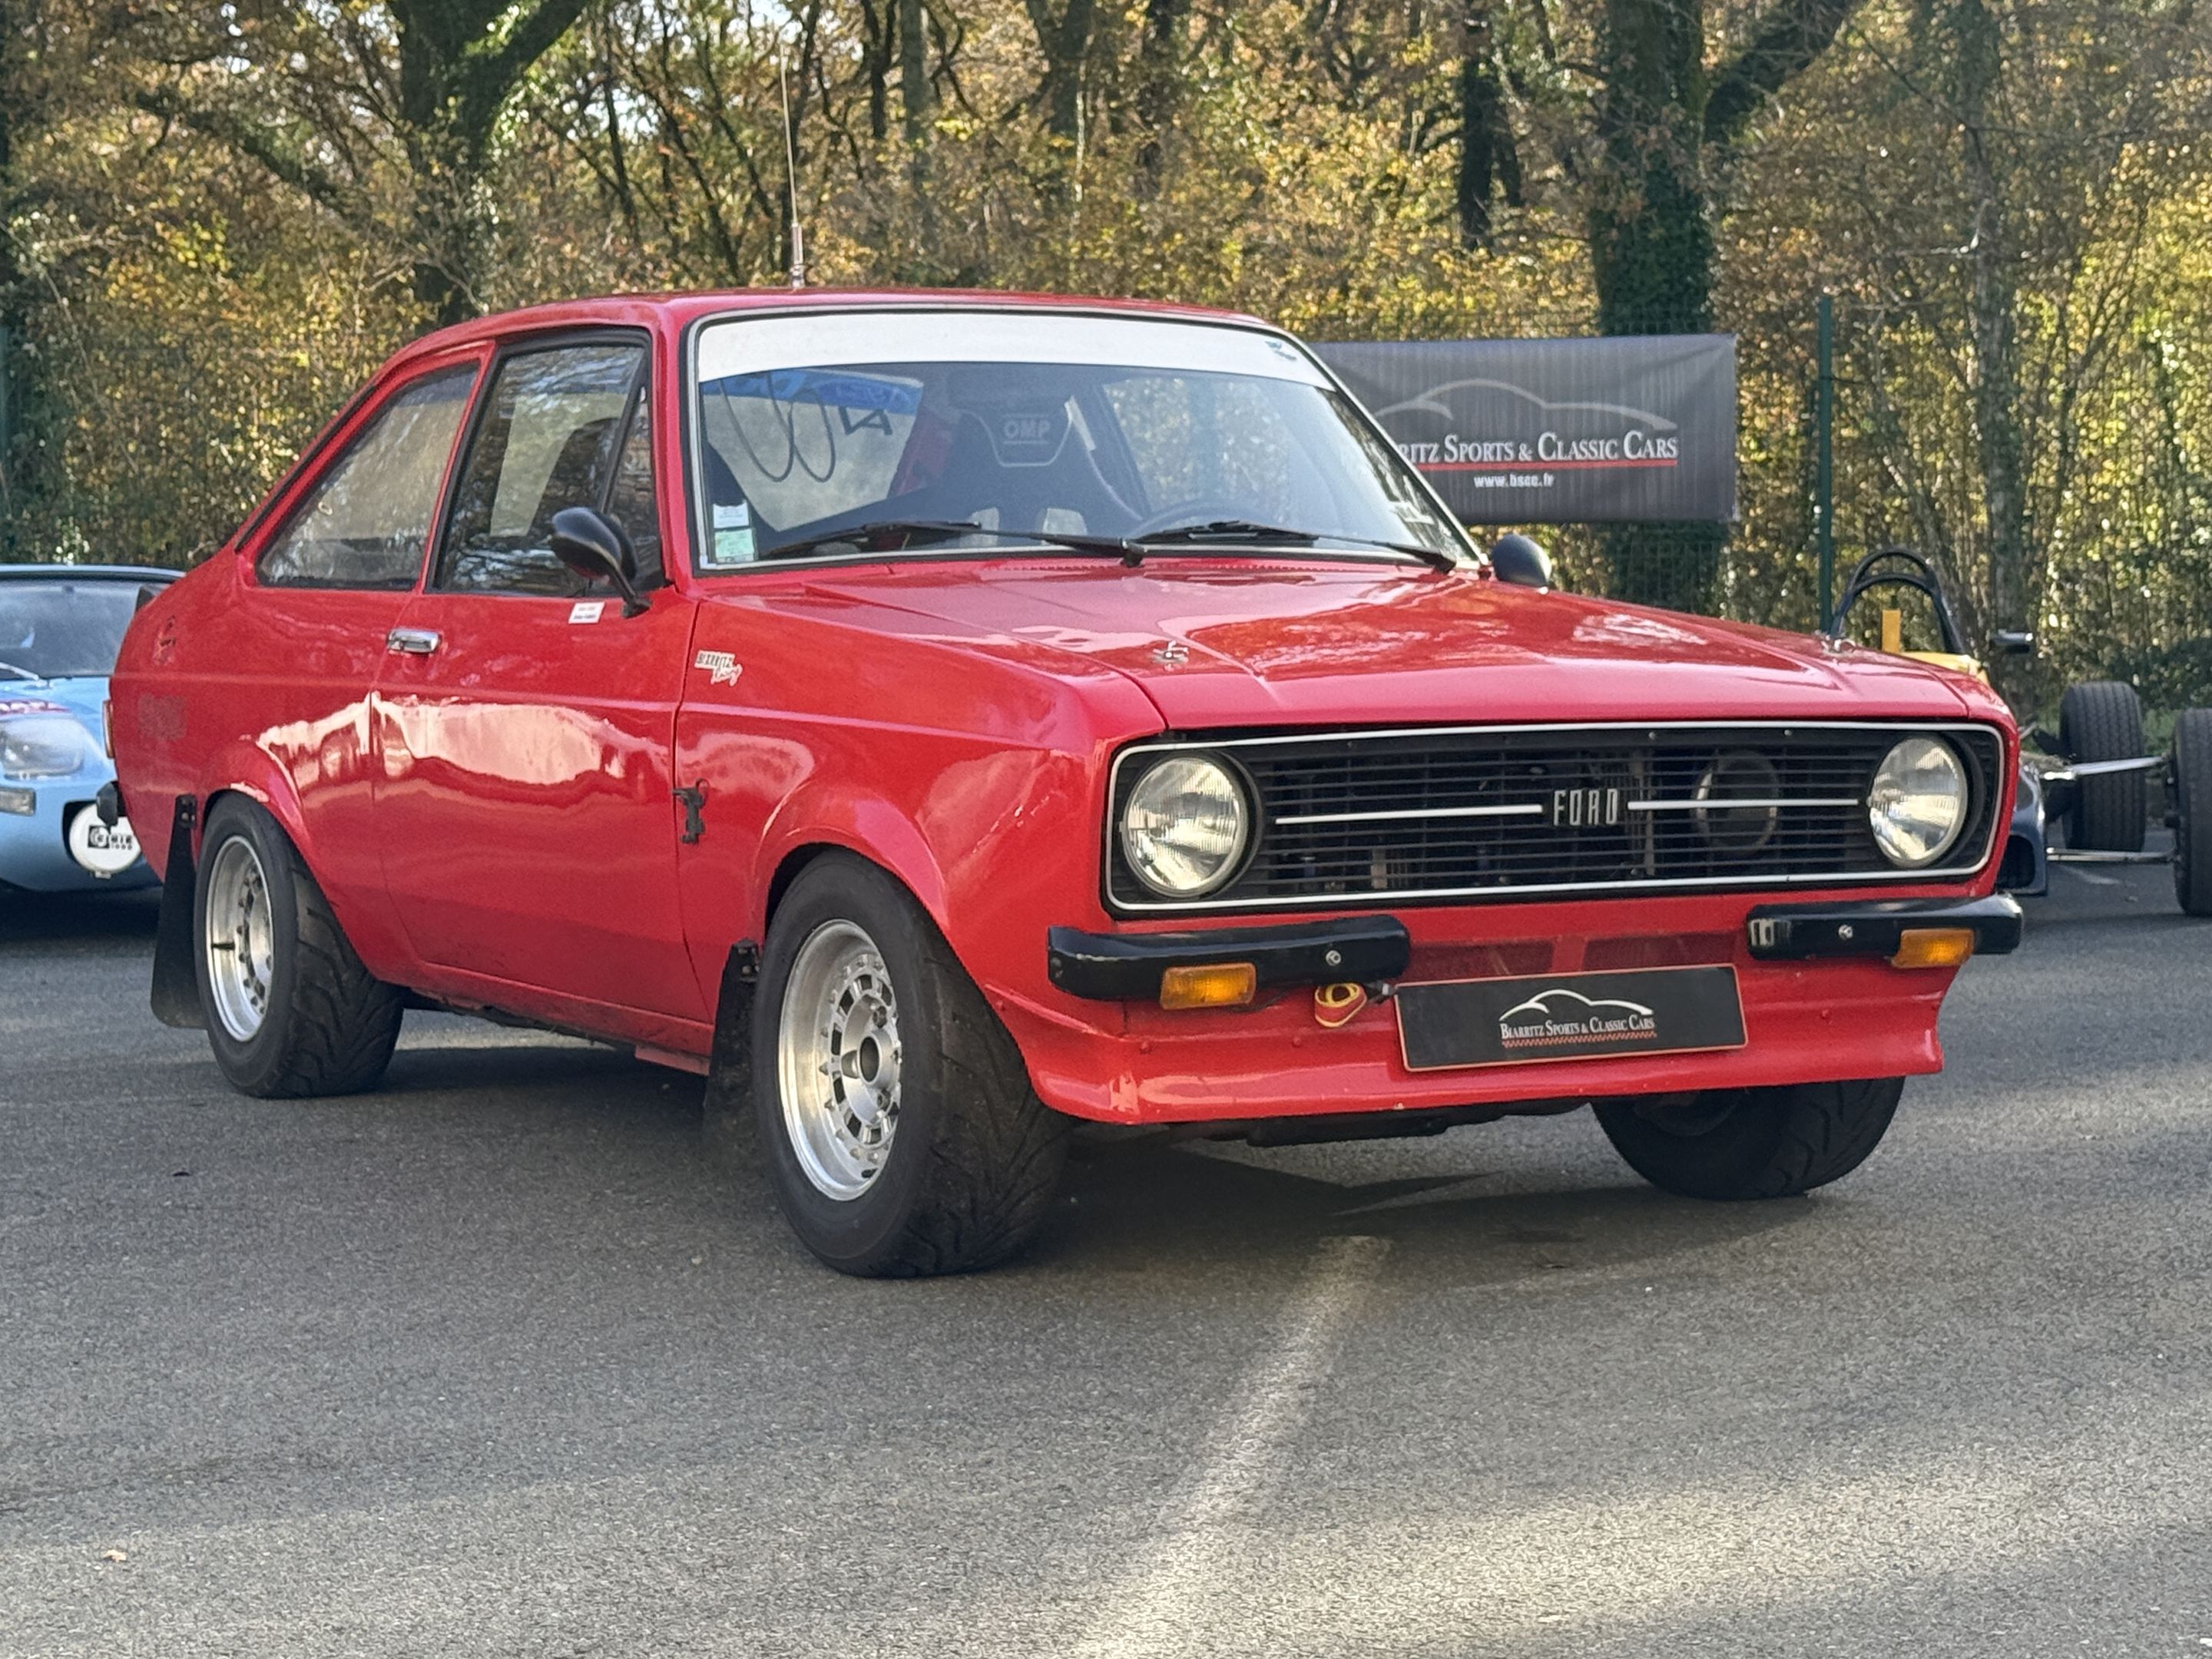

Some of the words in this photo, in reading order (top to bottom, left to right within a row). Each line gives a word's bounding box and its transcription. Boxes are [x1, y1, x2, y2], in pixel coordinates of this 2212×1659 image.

[1004, 419, 1051, 439] OMP
[1397, 442, 1439, 463] RITZ
[1444, 434, 1514, 462] SPORTS
[1518, 441, 1533, 462] &
[1538, 431, 1618, 461] CLASSIC
[1624, 429, 1678, 459] CARS
[1554, 788, 1618, 826] FORD
[1500, 1023, 1545, 1039] BIARRITZ
[1545, 1019, 1581, 1036] SPORTS
[1581, 1022, 1589, 1034] &
[1589, 1016, 1628, 1033] CLASSIC
[1628, 1014, 1655, 1031] CARS
